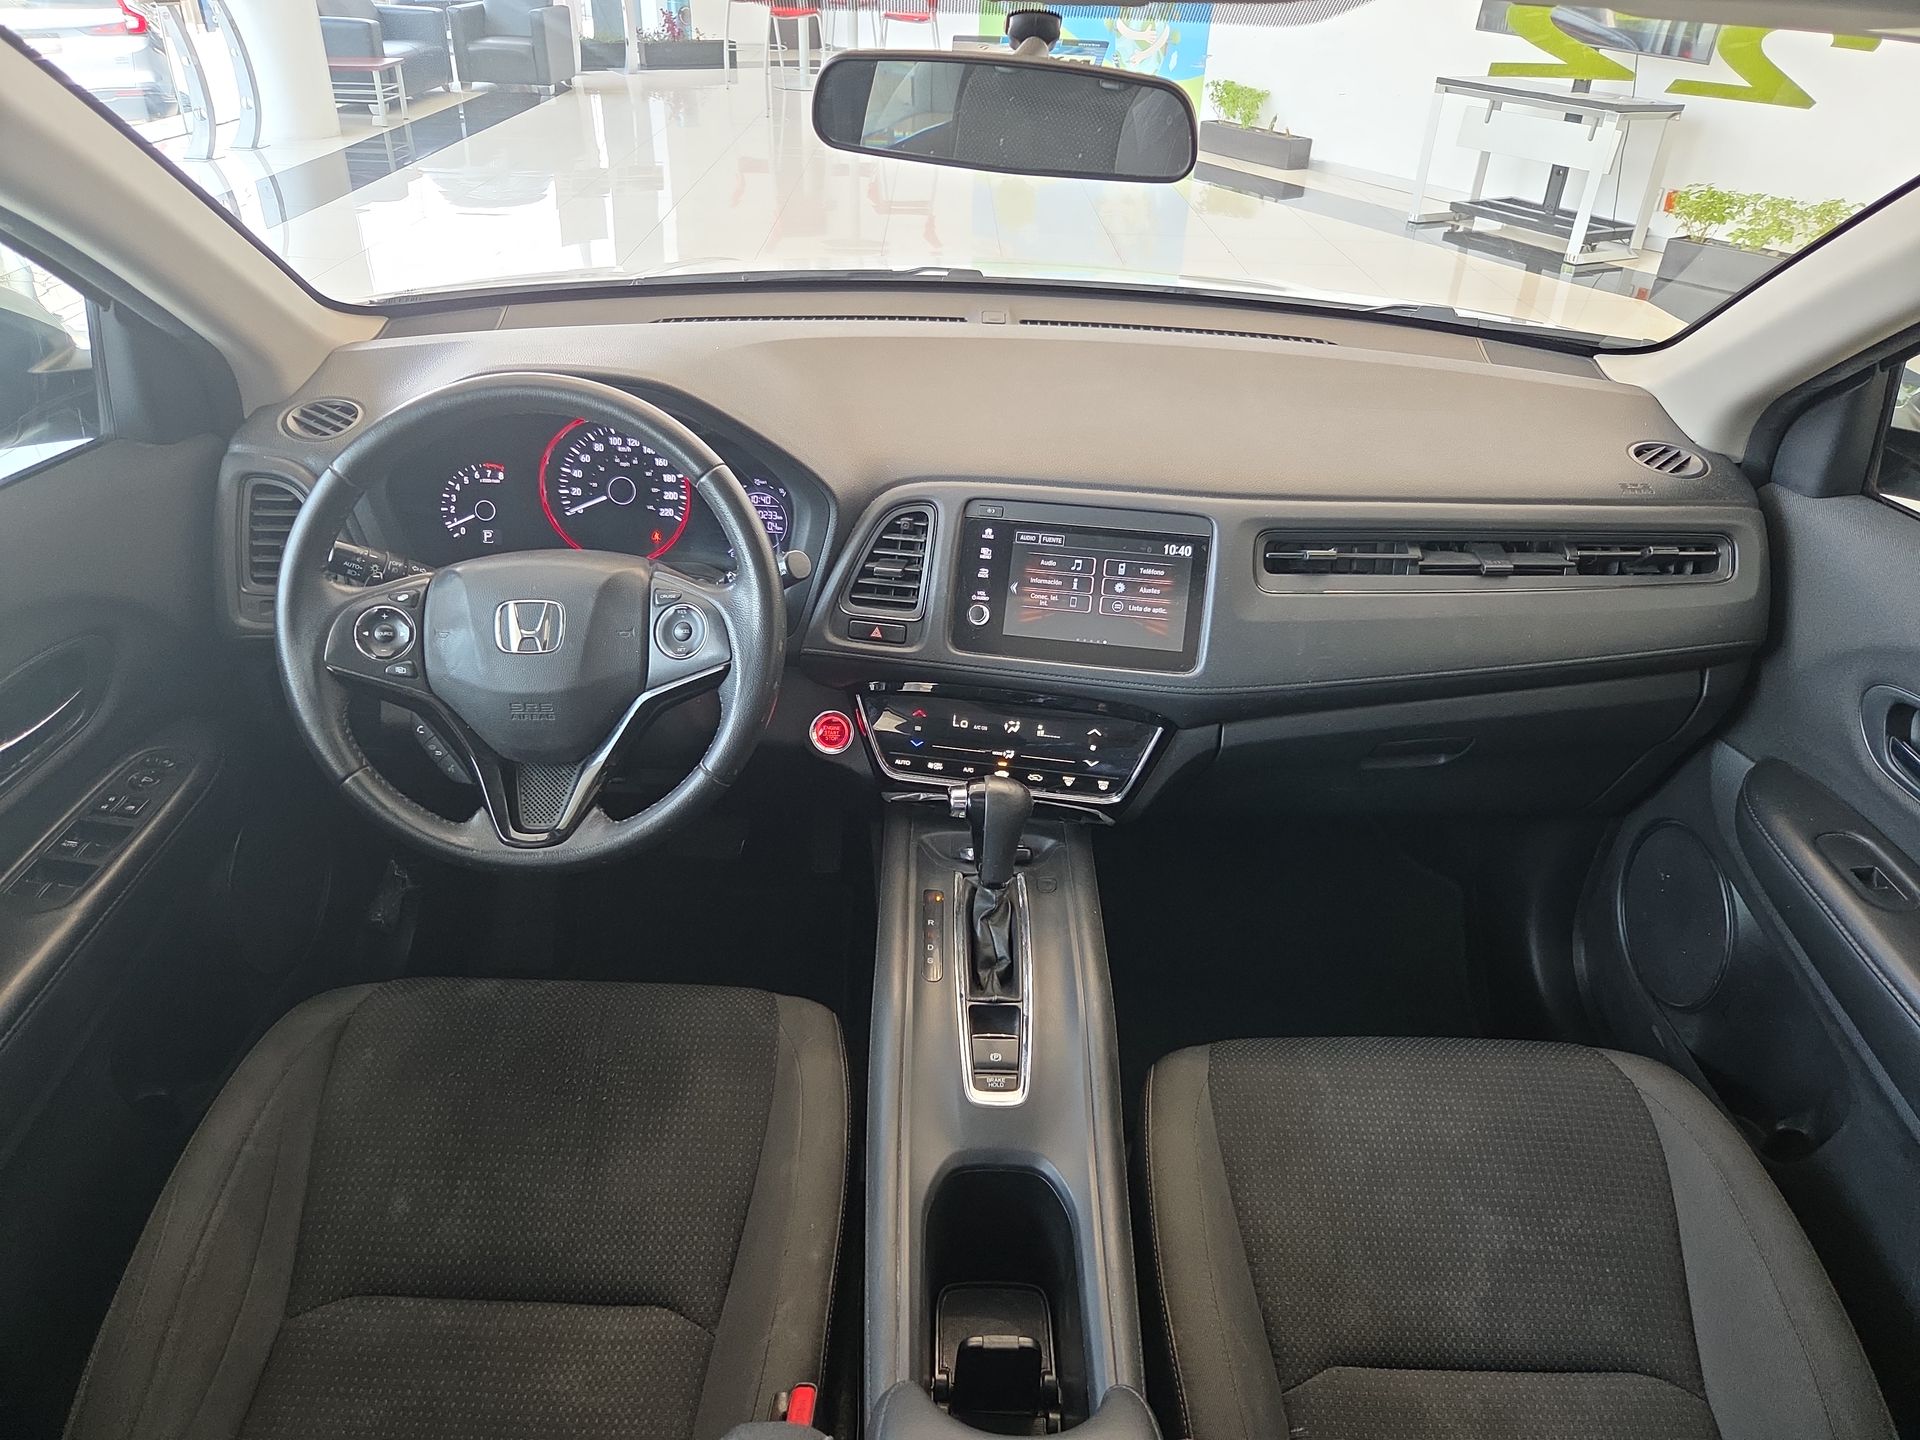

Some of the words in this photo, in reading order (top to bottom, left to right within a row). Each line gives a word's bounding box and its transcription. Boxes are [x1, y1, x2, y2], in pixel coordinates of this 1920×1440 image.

[608, 436, 622, 446] 100
[627, 438, 640, 447] 120
[594, 443, 604, 452] 80
[579, 454, 591, 463] 60
[654, 458, 668, 467] 160
[474, 470, 480, 479] 6
[486, 469, 492, 478] 7
[498, 471, 505, 480] 8
[572, 469, 583, 478] 40
[662, 473, 677, 483] 180
[463, 476, 469, 485] 5
[454, 483, 460, 492] 4
[570, 487, 582, 496] 20
[450, 494, 457, 502] 3
[663, 491, 679, 501] 200
[450, 505, 456, 514] 2
[659, 507, 675, 517] 220
[460, 526, 466, 535] 0
[1019, 534, 1037, 542] AUDIO
[1042, 536, 1063, 545] FUENTE
[1163, 543, 1193, 557] 10:40
[343, 561, 360, 570] AUTO
[1040, 559, 1057, 567] Audio
[1139, 567, 1165, 576] Teléfono
[1029, 577, 1063, 586] Información
[1138, 586, 1161, 595] Ajustes
[1030, 592, 1049, 600] Conec.
[1128, 604, 1142, 612] Lista
[511, 713, 556, 721] AIRBAG
[952, 713, 969, 729] Lo
[894, 759, 911, 767] AUTO
